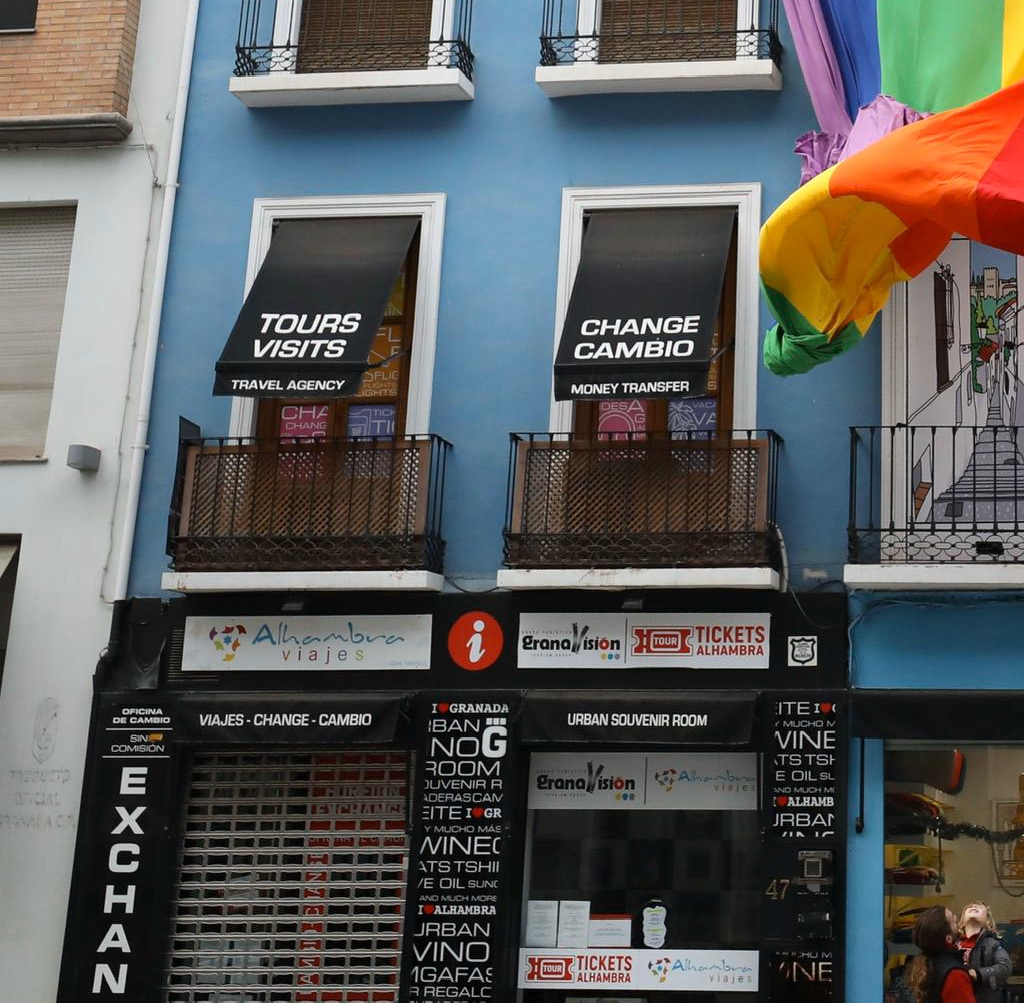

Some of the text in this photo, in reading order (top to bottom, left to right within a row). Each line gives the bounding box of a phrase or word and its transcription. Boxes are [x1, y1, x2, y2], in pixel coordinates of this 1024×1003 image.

[261, 312, 362, 334] TOURS
[580, 315, 701, 336] CHANGE
[253, 339, 348, 358] VISITS
[574, 340, 695, 359] CAMBIO
[231, 379, 346, 391] TRAVEL AGENCY
[571, 381, 690, 395] MONEY TRANSFER
[251, 621, 405, 646] Alhambra
[695, 625, 766, 645] TICKETS
[653, 635, 678, 646] TOUR
[282, 646, 365, 665] viajes
[696, 644, 764, 656] ALHAMBRA
[121, 708, 164, 716] OFICINA
[449, 703, 509, 714] GRANADA
[775, 701, 811, 716] ITE
[112, 717, 171, 725] DE CAMBIO
[199, 713, 245, 727] VIAJES
[253, 713, 310, 727] CHANGE
[318, 713, 373, 727] CAMBIO
[428, 718, 481, 733] BAN
[567, 713, 708, 727] URBAN SOUVENIR ROOM
[782, 720, 824, 728] MUCHO
[130, 734, 149, 743] SIN
[111, 742, 165, 753] COMISIÓN
[791, 770, 818, 782] OIL
[794, 786, 822, 794] MUCH
[787, 796, 835, 807] ALHAMB
[434, 825, 475, 834] MUCHO
[453, 860, 500, 873] TSHI
[439, 877, 466, 889] OIL
[765, 878, 791, 900] 47
[434, 904, 497, 915] ALHAMBRA
[412, 941, 490, 963] VINO
[542, 955, 753, 974] TOUR TICKETS Alhambra
[576, 972, 753, 986] ALHAMBRA viajes
